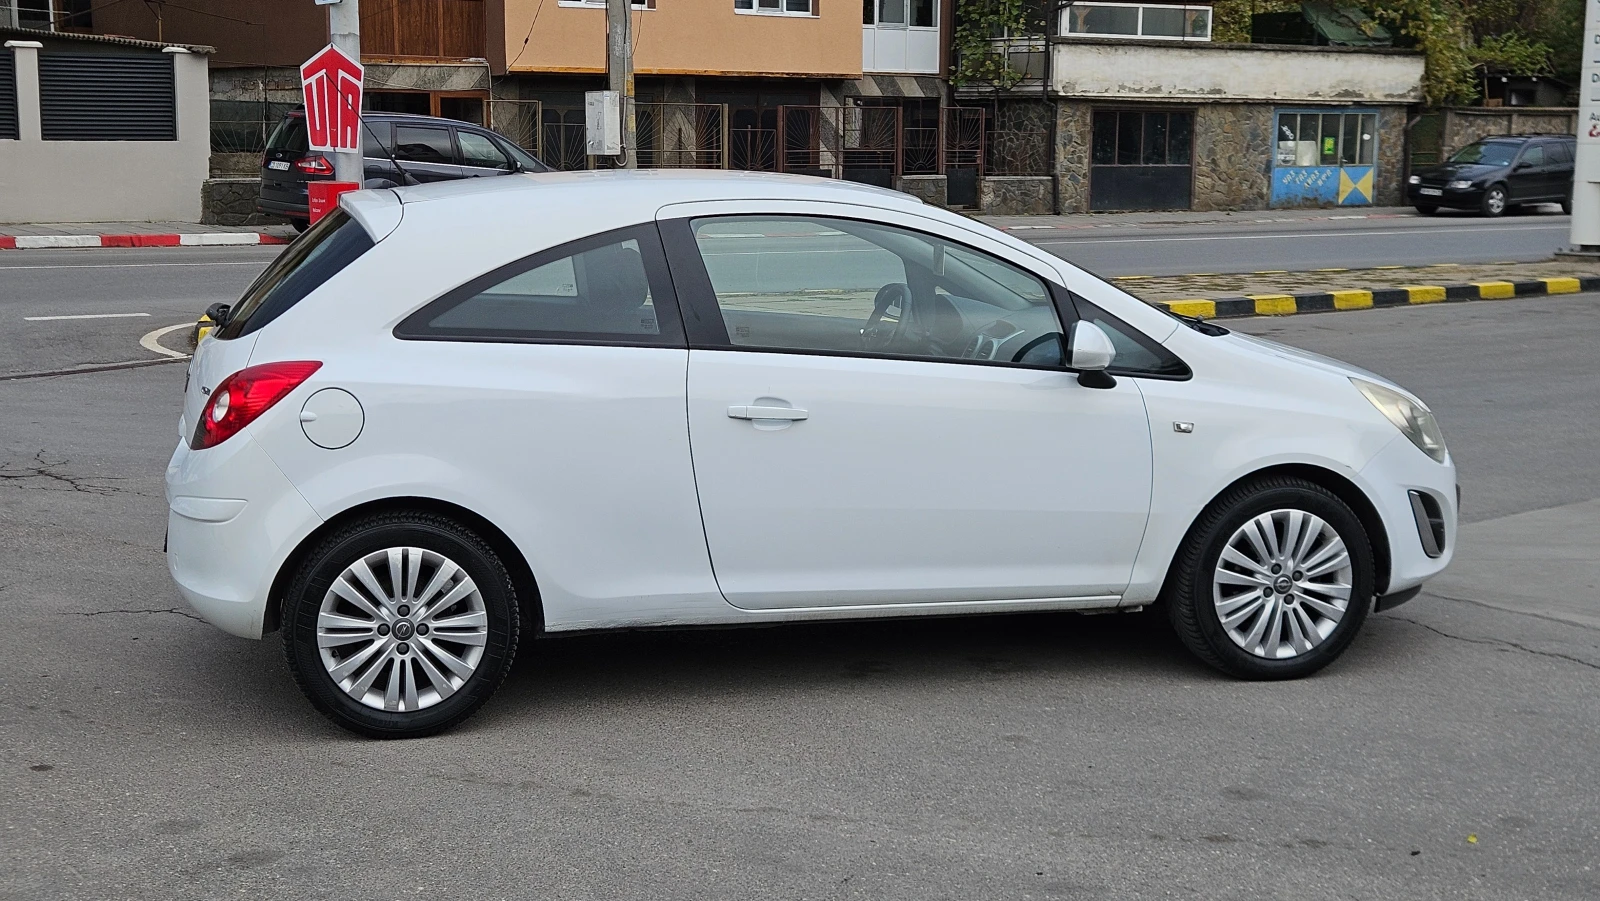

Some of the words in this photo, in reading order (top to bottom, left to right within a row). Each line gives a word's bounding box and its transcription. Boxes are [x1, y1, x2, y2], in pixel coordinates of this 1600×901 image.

[302, 48, 362, 149] UTA
[1282, 170, 1296, 185] УАЗ
[1295, 169, 1308, 185] ГАЗ
